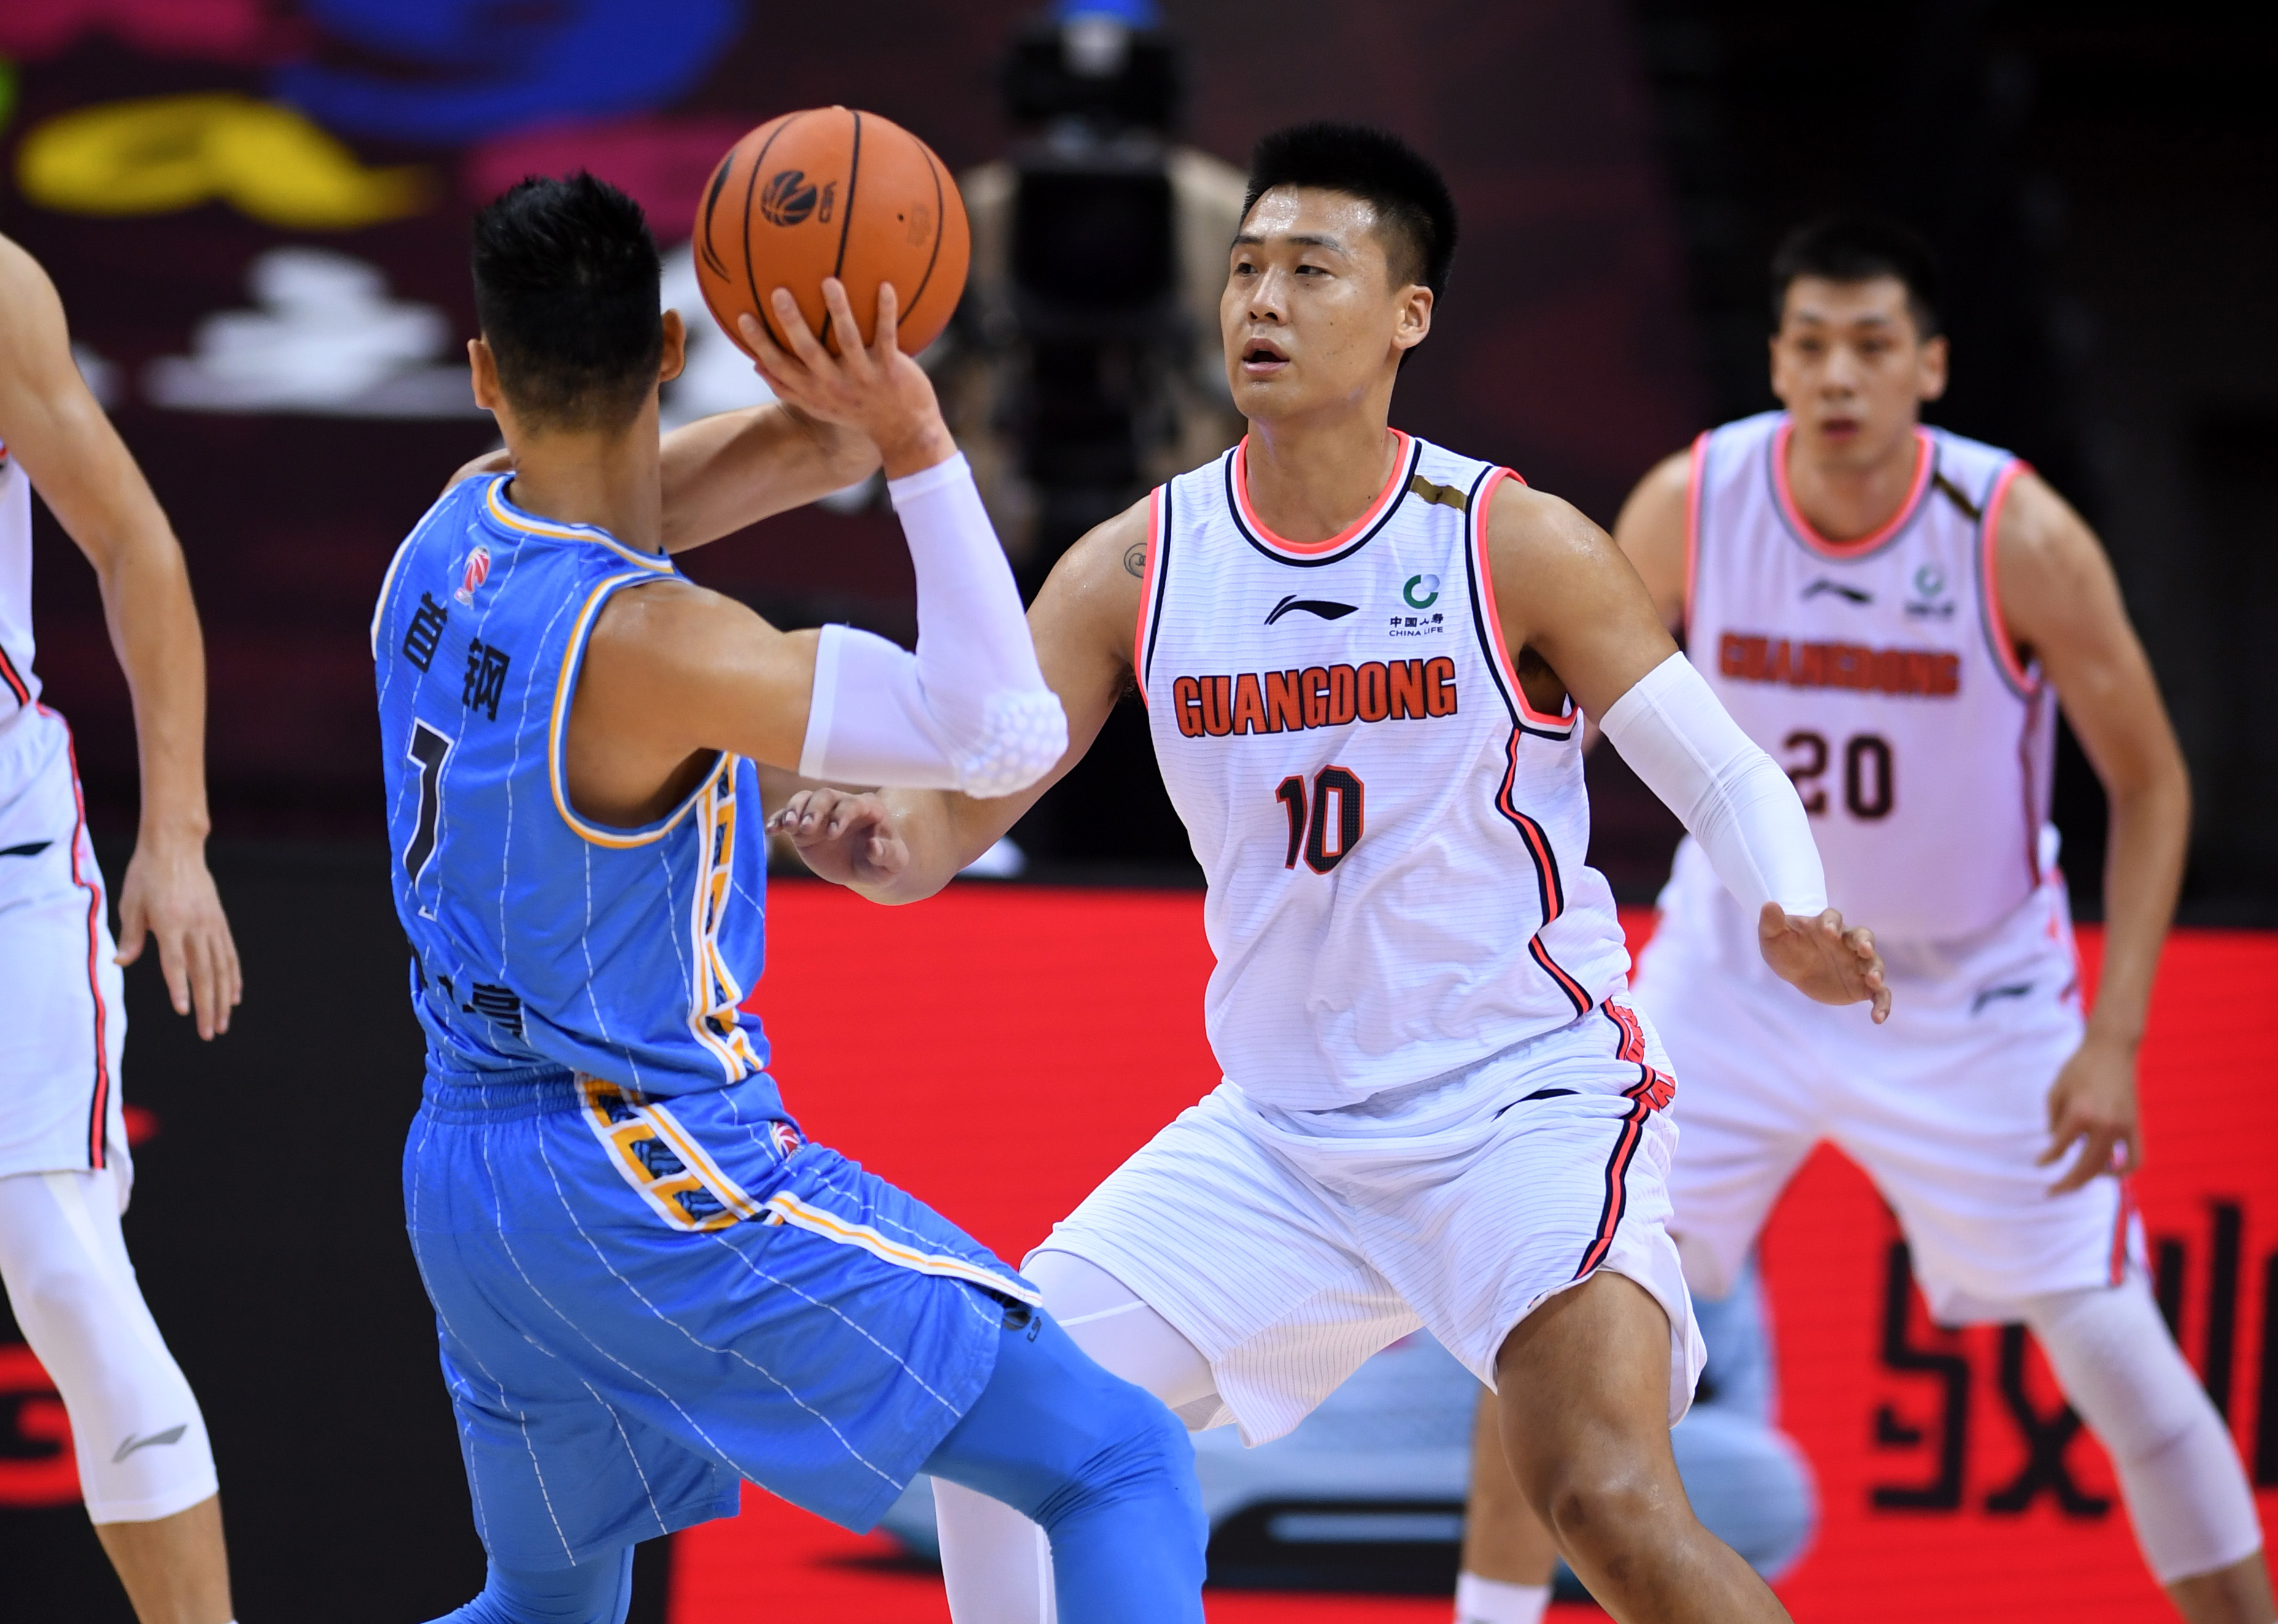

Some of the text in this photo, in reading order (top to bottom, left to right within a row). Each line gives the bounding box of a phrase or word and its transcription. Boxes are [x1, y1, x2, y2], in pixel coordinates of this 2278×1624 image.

[403, 591, 510, 722] 首钢
[1424, 626, 1443, 635] LIFE
[1173, 656, 1458, 738] GUANGDONG
[1275, 764, 1365, 875] 10
[1783, 733, 1894, 820] 20
